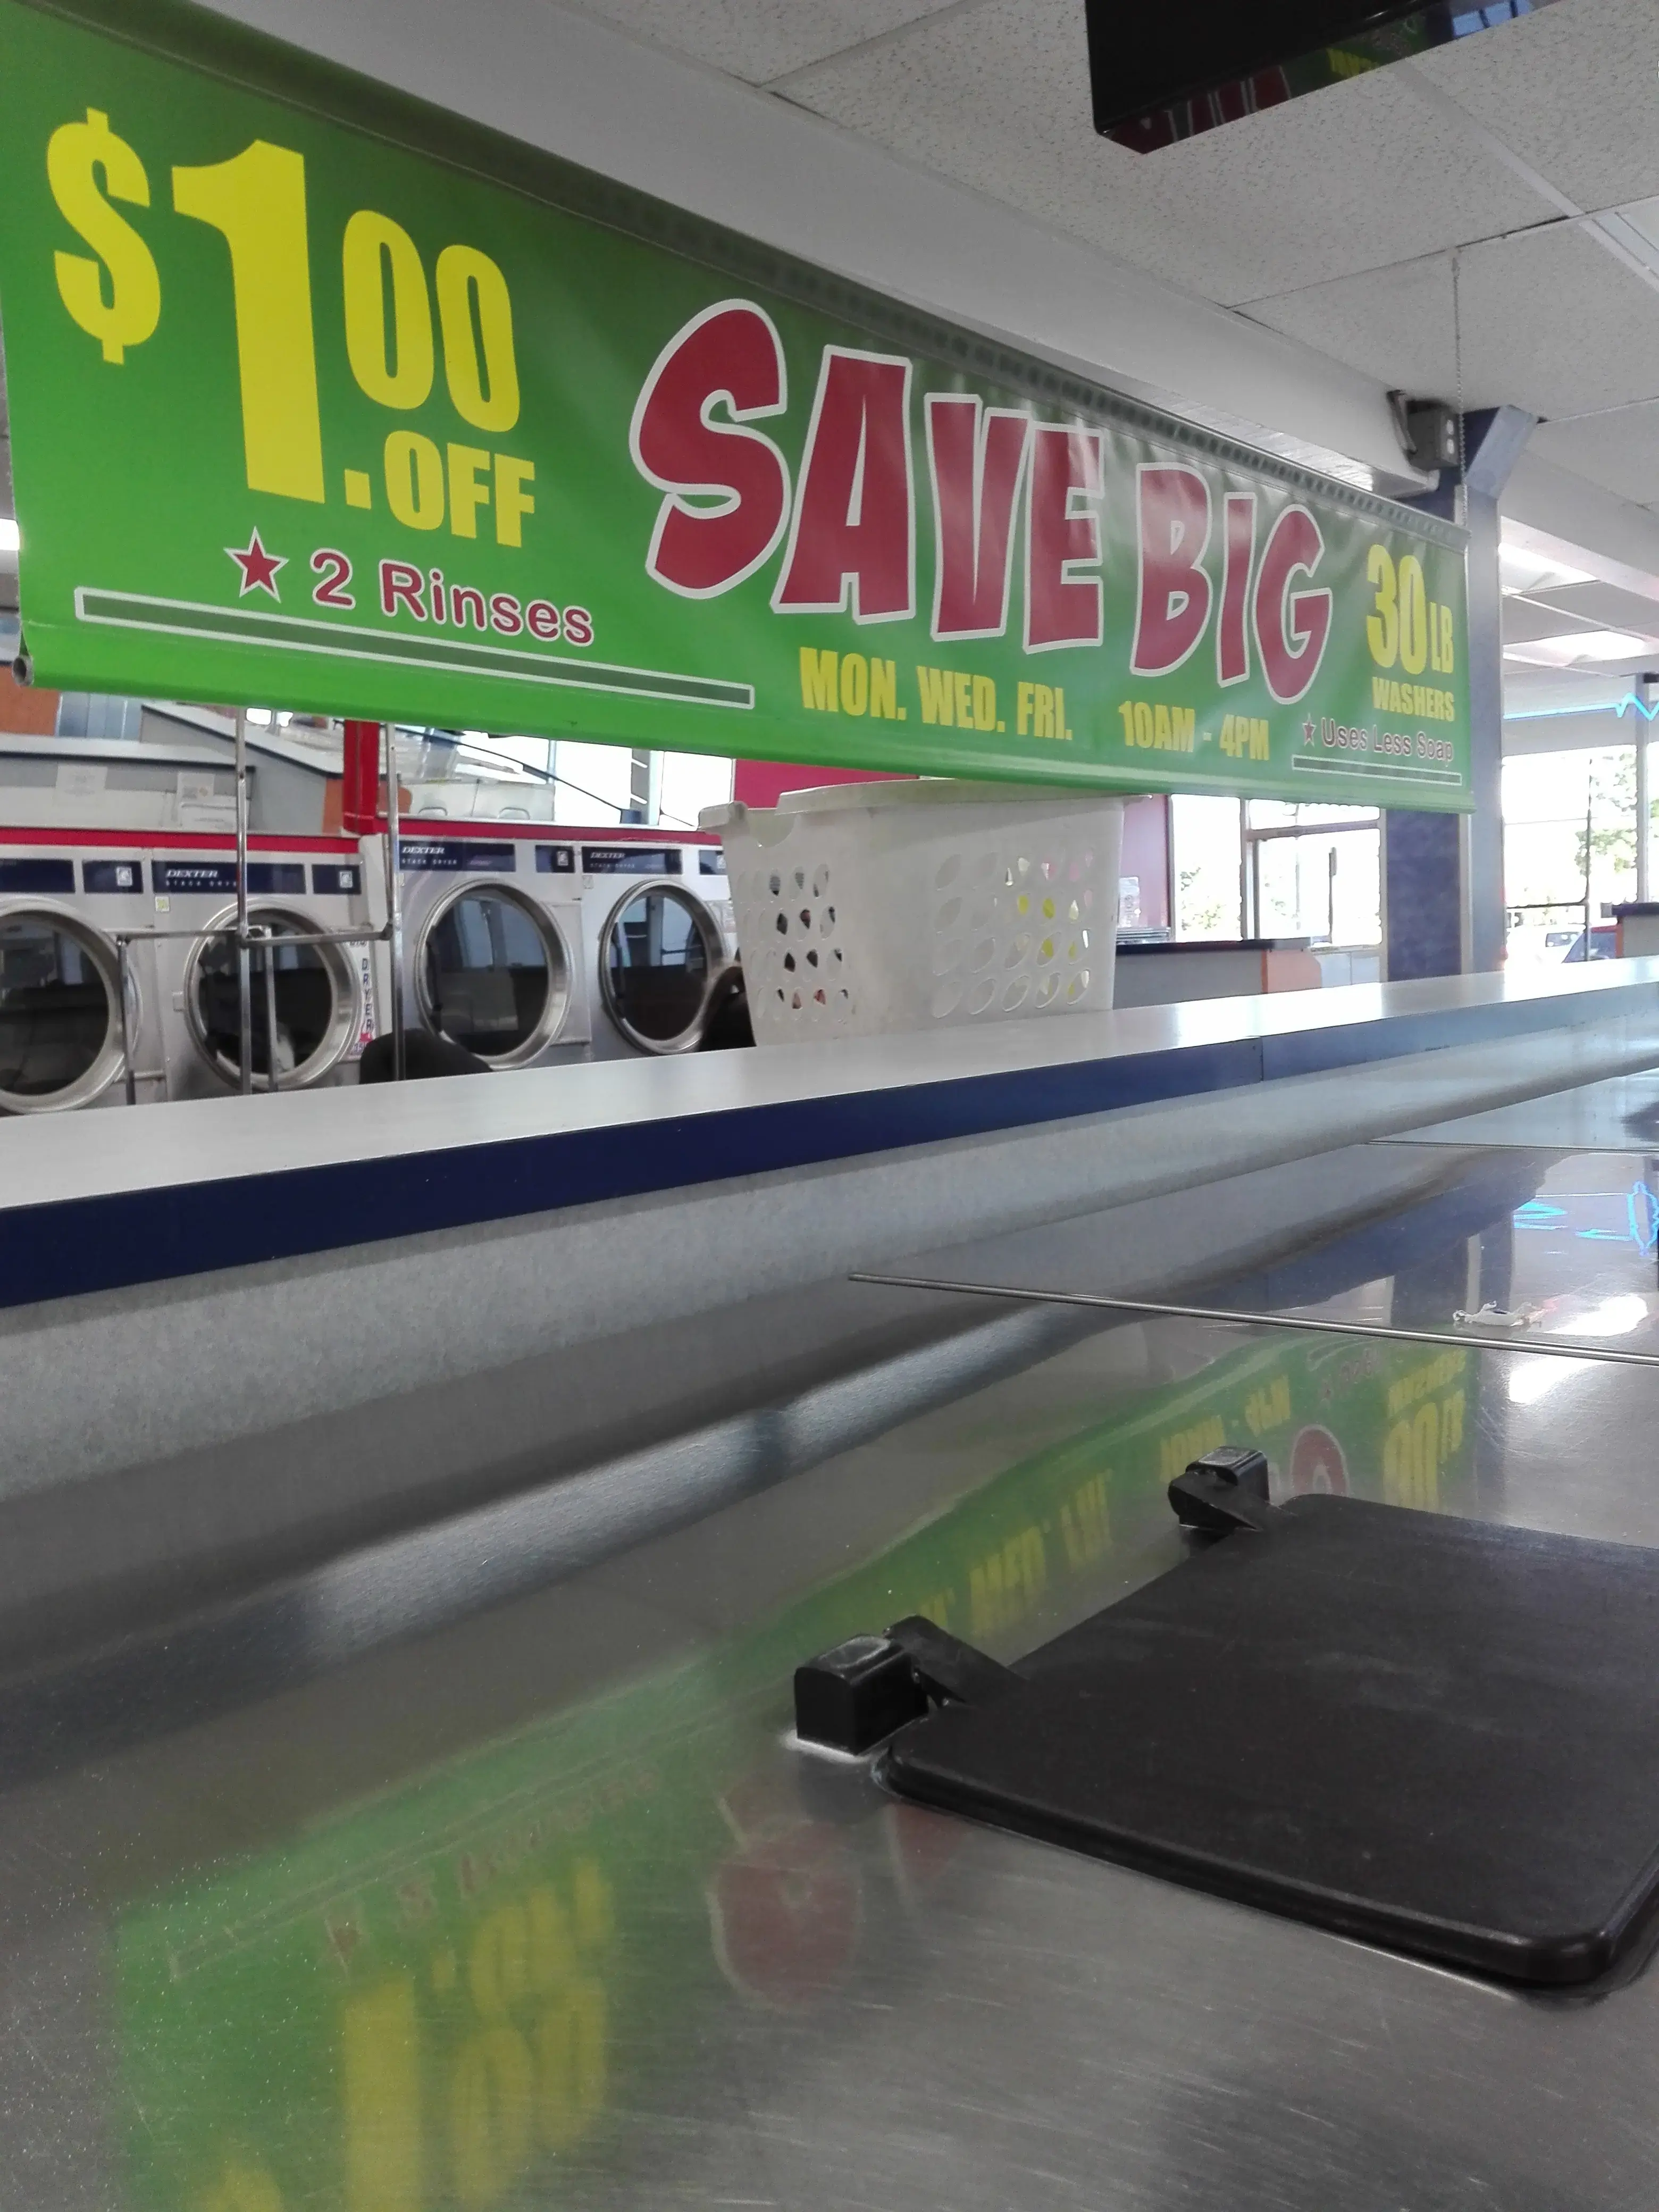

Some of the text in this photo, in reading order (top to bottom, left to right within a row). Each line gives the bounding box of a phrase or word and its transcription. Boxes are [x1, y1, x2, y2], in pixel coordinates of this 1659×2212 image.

[384, 430, 534, 548] OFF
[629, 298, 1333, 705] SAVE BIG
[309, 547, 594, 647] 2 Rinses
[799, 647, 906, 721] MON.
[916, 665, 1006, 733] WED.
[1017, 681, 1073, 741] FRI.
[1118, 700, 1195, 753] 10AM
[1219, 714, 1270, 761] 4PM
[1371, 676, 1455, 722] WASHERS
[1321, 717, 1453, 767] Uses Less Soap
[166, 869, 219, 878] DEXTER
[401, 846, 445, 854] DEXTER
